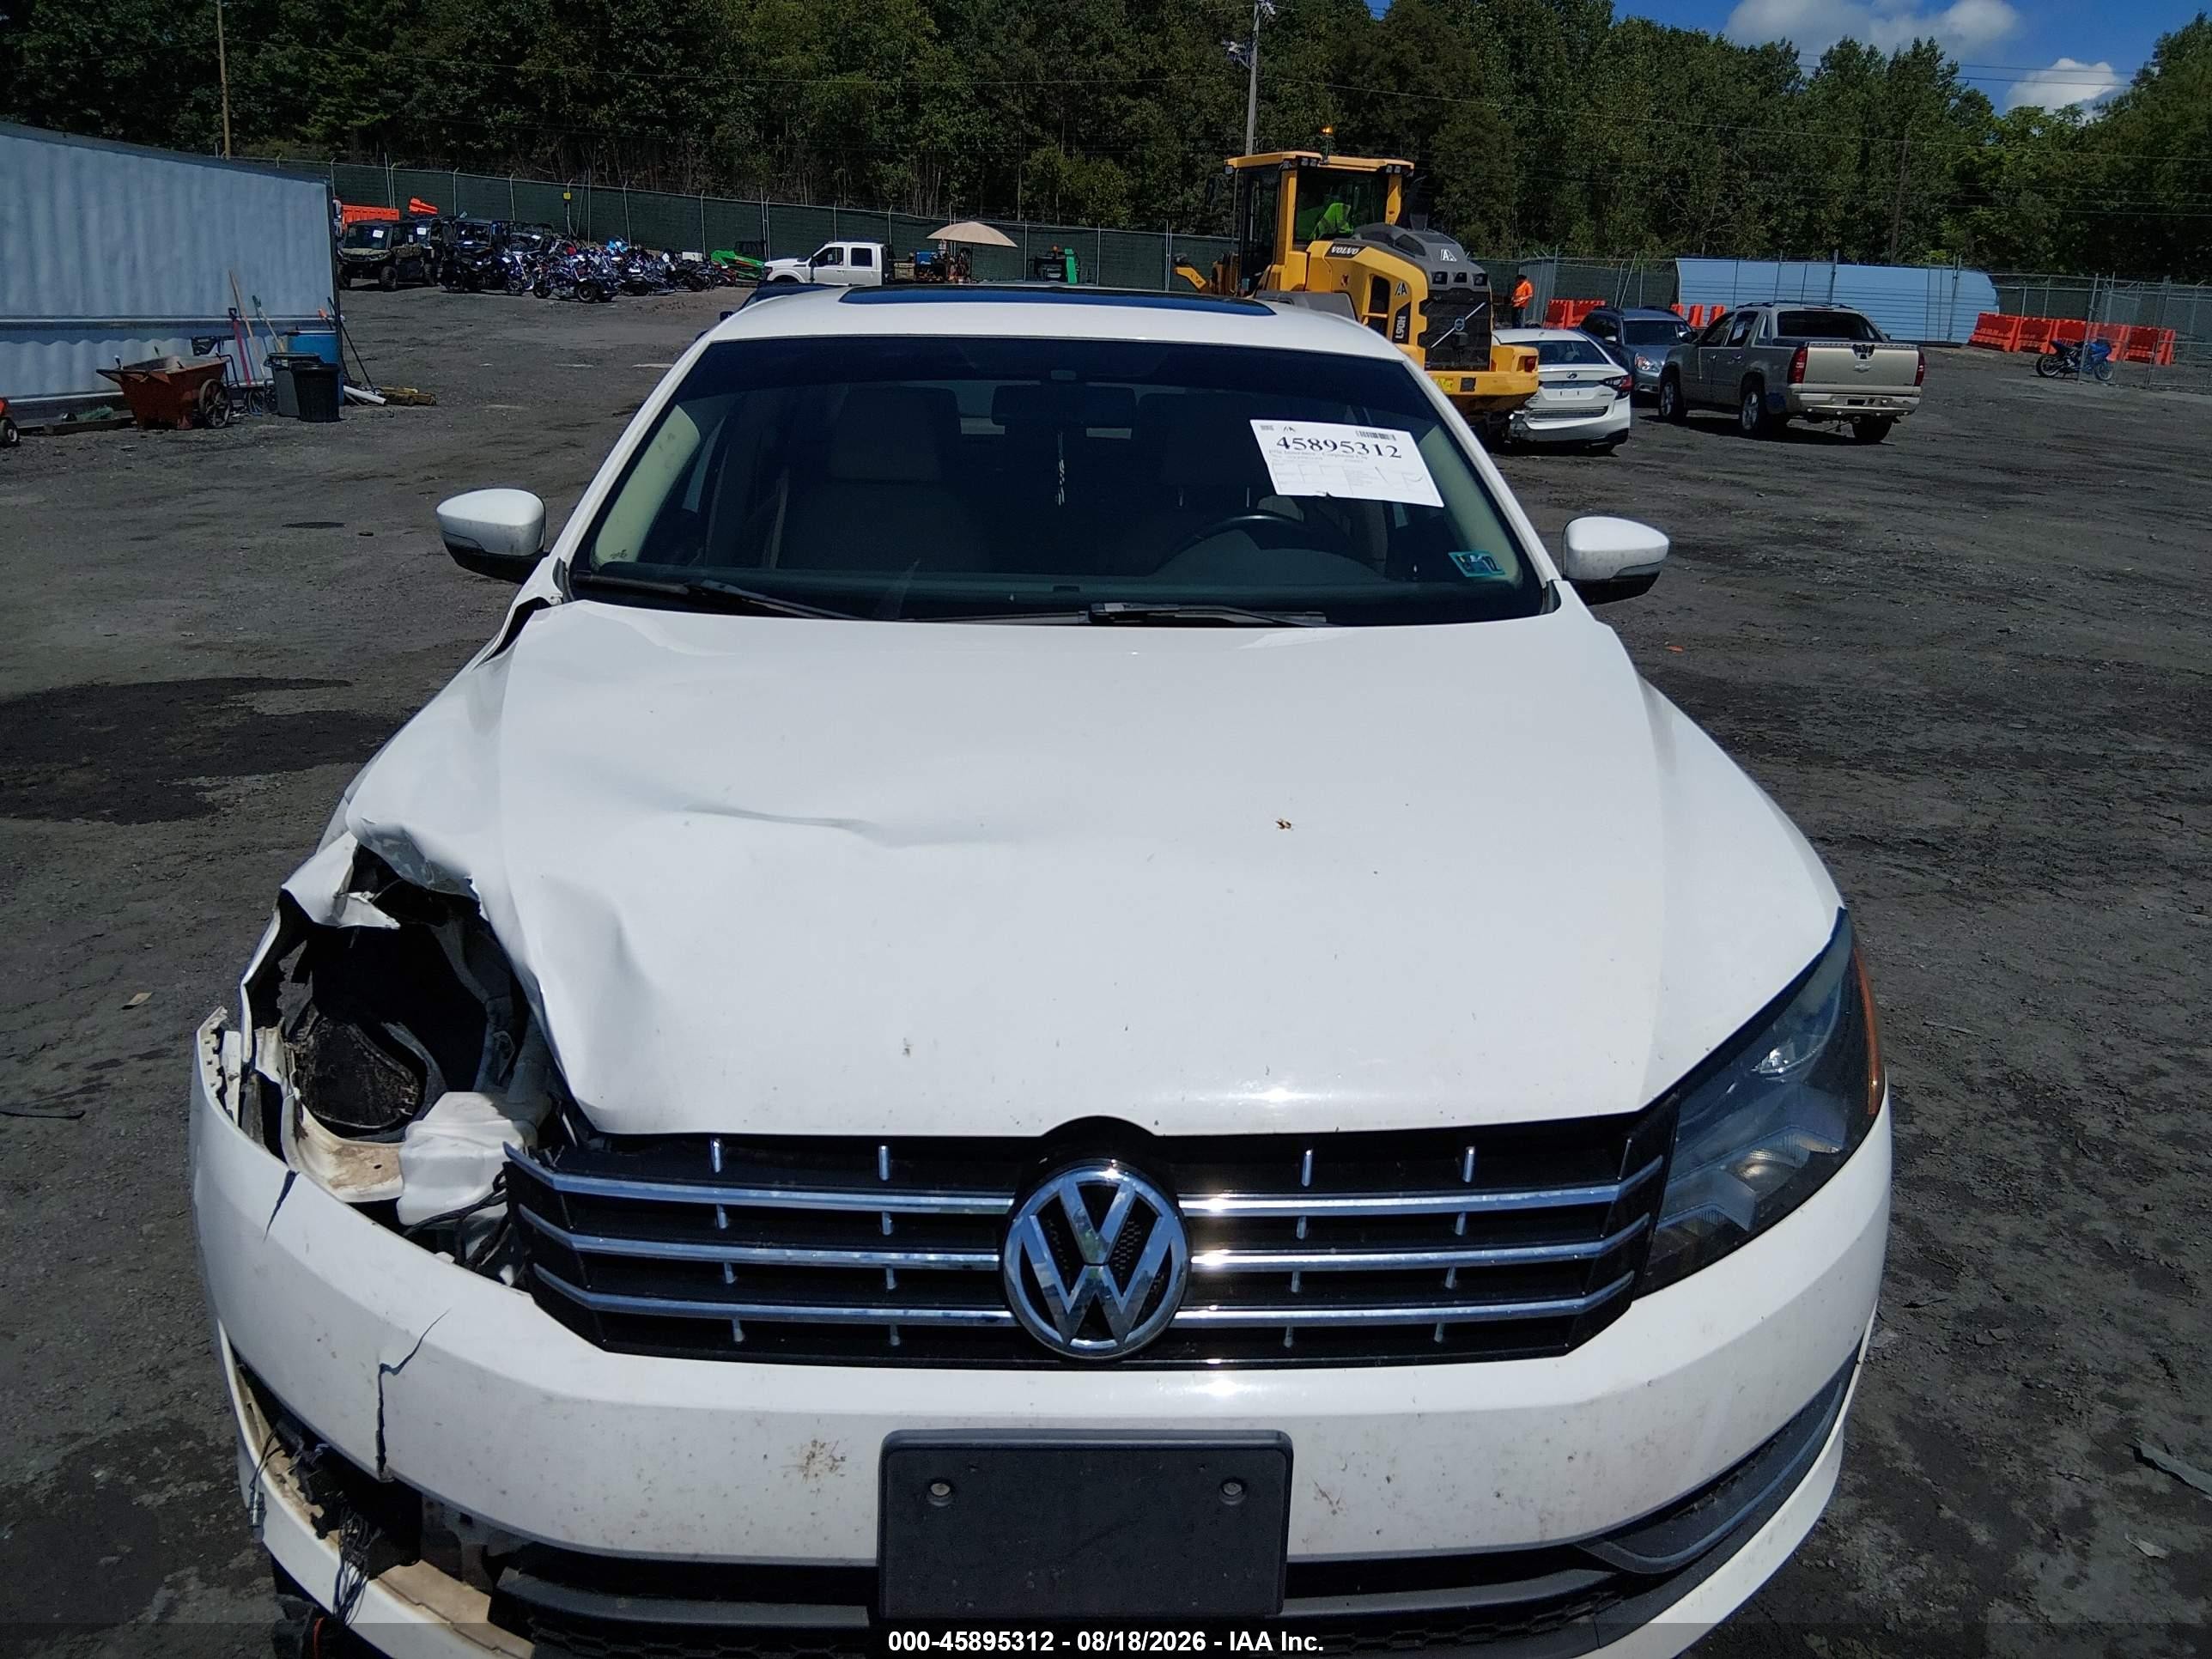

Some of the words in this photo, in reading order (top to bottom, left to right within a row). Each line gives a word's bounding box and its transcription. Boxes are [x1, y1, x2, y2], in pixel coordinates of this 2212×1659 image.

[1332, 246, 1359, 255] VOLVO
[1395, 315, 1407, 339] L90H
[1276, 436, 1402, 459] 45895312
